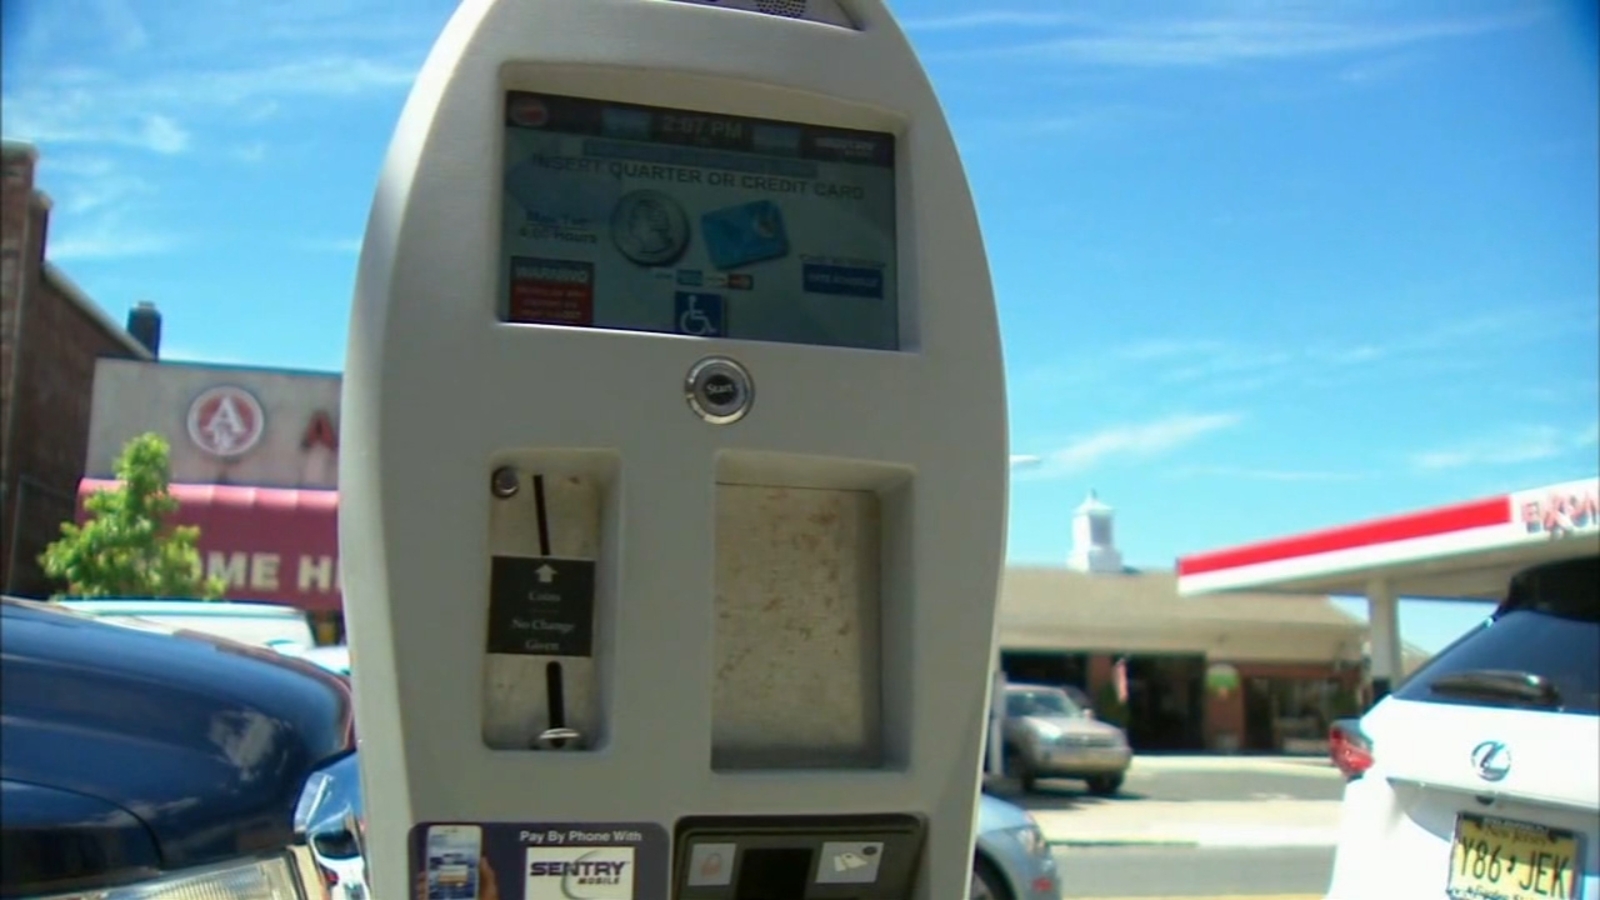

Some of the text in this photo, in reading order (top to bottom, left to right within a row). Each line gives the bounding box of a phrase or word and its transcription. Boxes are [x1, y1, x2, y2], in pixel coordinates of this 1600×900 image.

[709, 119, 743, 140] PM
[532, 152, 865, 201] INSERT QUARTER OR CREDIT CARD
[511, 618, 576, 635] No Change
[519, 830, 643, 845] Pay By Phone With
[530, 861, 625, 876] SENTRY
[1461, 836, 1570, 899] Y86 JEK
[577, 877, 620, 885] MOBILE
